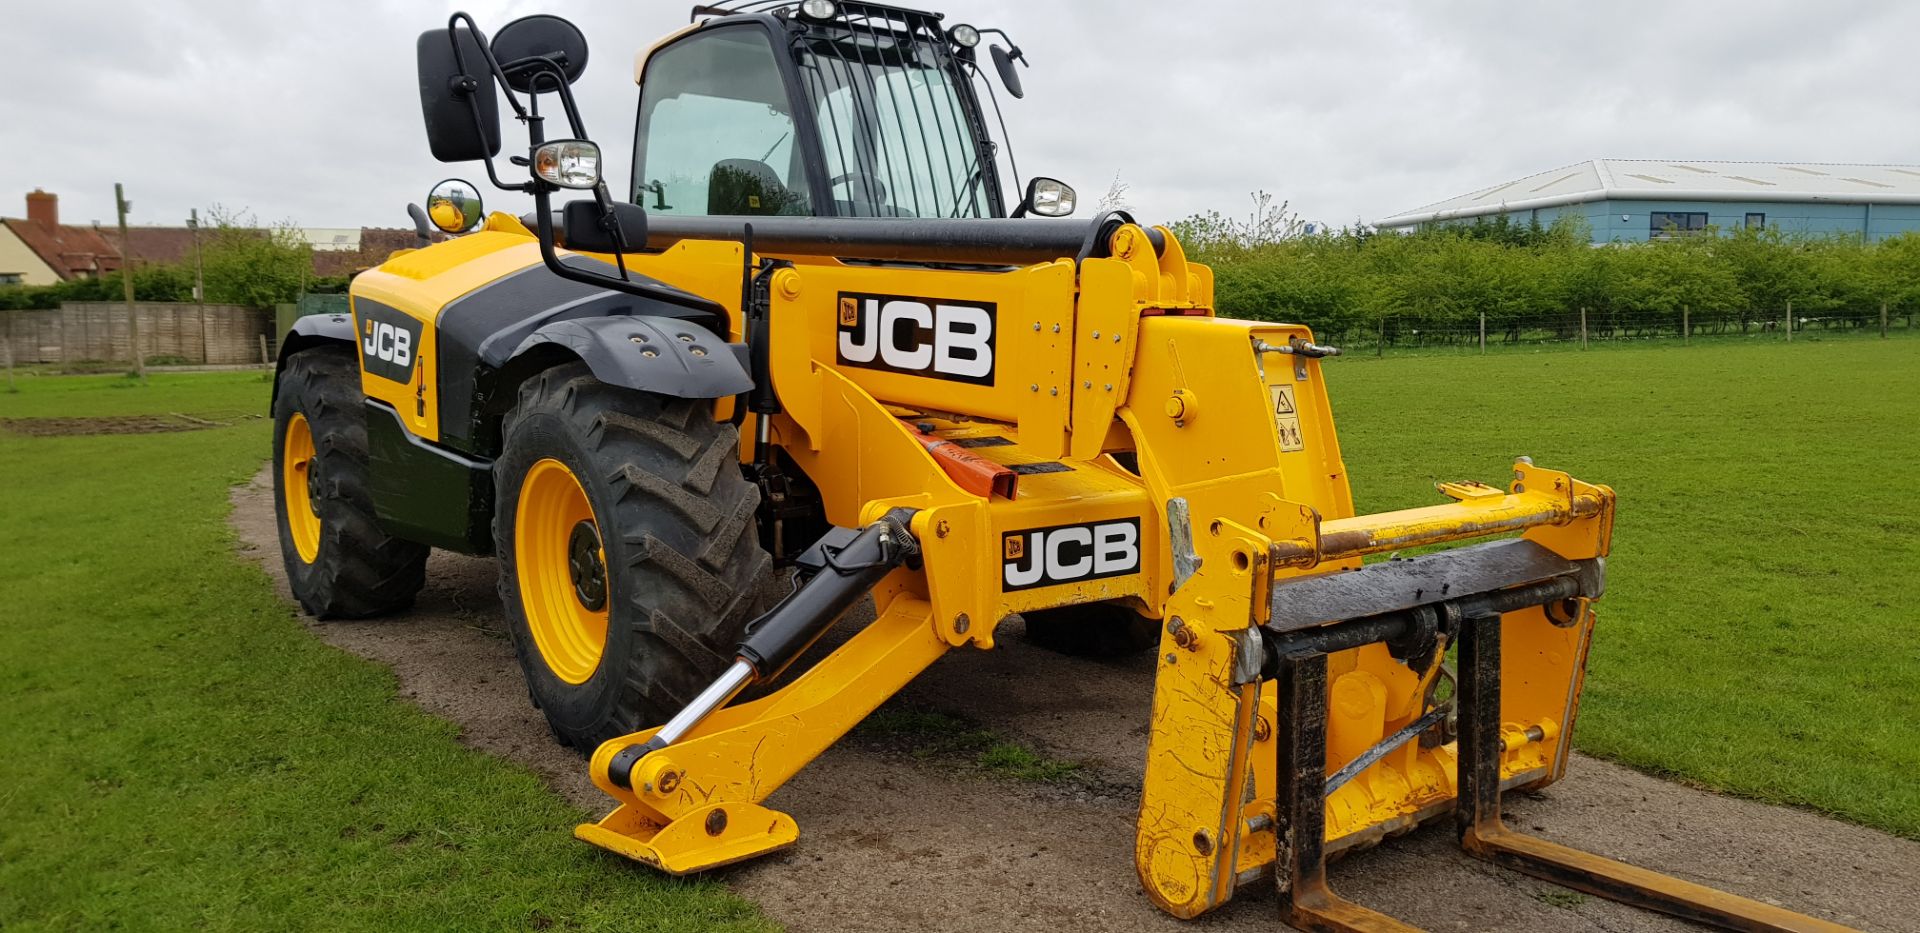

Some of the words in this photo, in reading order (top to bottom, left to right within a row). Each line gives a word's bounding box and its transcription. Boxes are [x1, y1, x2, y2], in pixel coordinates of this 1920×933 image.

[365, 320, 411, 367] JCB
[839, 299, 993, 378] JCB
[1005, 522, 1138, 586] JCB
